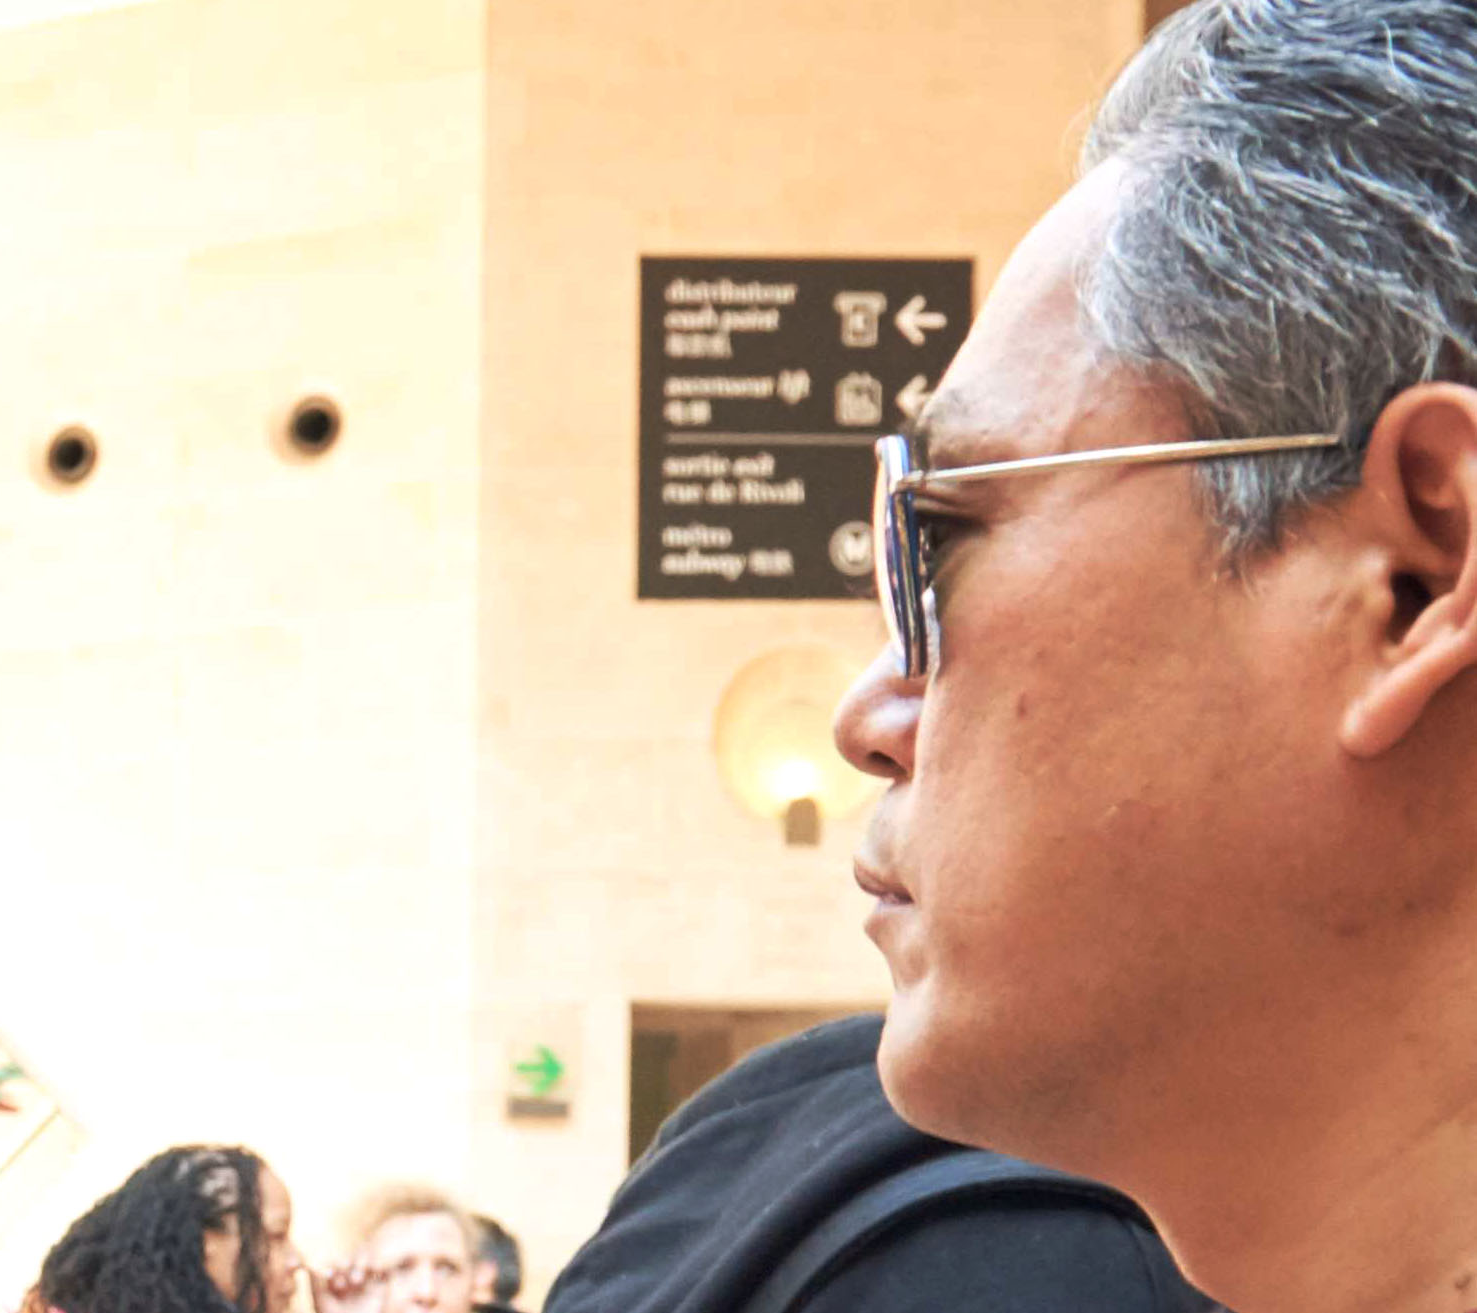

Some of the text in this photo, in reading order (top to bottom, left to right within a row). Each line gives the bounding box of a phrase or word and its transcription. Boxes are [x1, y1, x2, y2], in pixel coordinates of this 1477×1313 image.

[663, 478, 805, 504] rue de Rivoli
